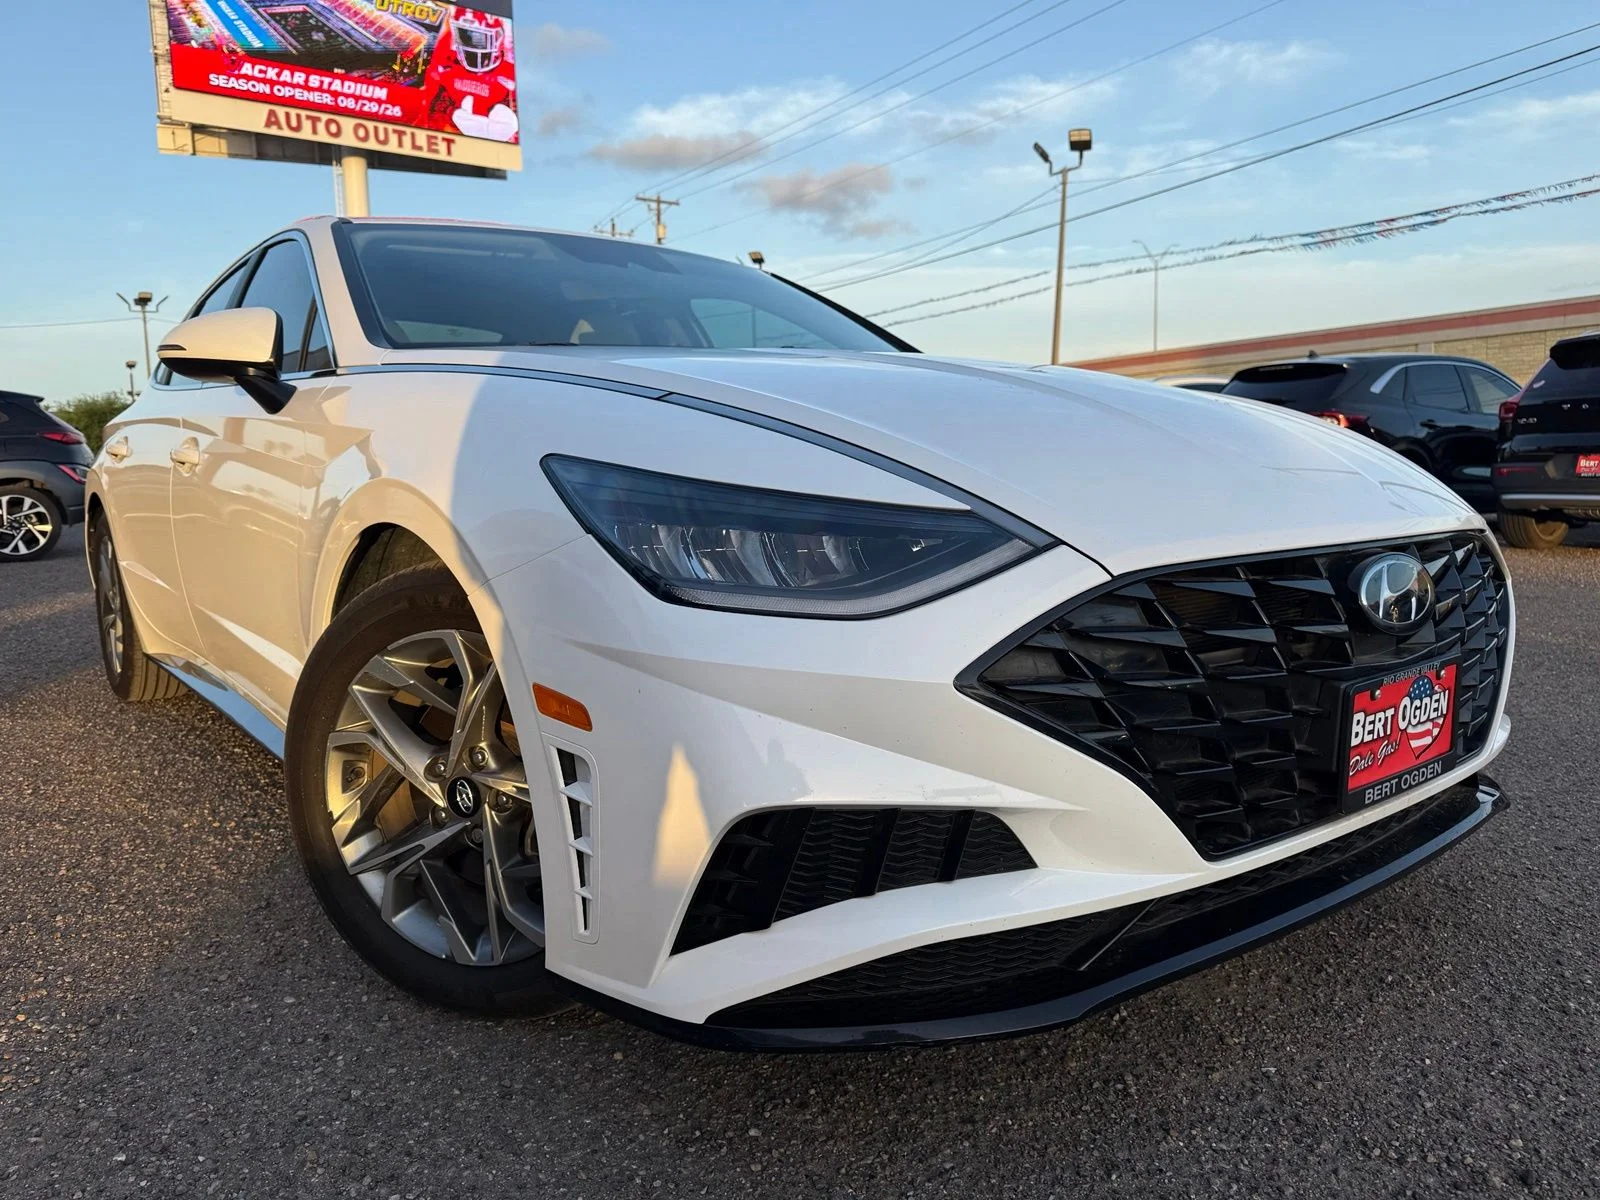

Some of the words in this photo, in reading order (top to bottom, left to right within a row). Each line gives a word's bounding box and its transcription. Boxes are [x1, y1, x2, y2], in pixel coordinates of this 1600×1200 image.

[208, 73, 271, 95] SEASON
[273, 85, 335, 105] OPENER:
[337, 95, 402, 117] 08/29/26
[308, 74, 388, 100] STADIUM
[263, 108, 342, 139] AUTO
[353, 122, 456, 157] OUTLET
[1382, 675, 1395, 687] RIO
[1395, 668, 1420, 682] GRANDE
[1420, 661, 1441, 674] VALLEY
[1351, 707, 1395, 747] BERT
[1398, 690, 1449, 730] OGDEN
[1349, 751, 1374, 776] Dale
[1365, 778, 1398, 804] BERT
[1401, 761, 1442, 788] OGDEN
